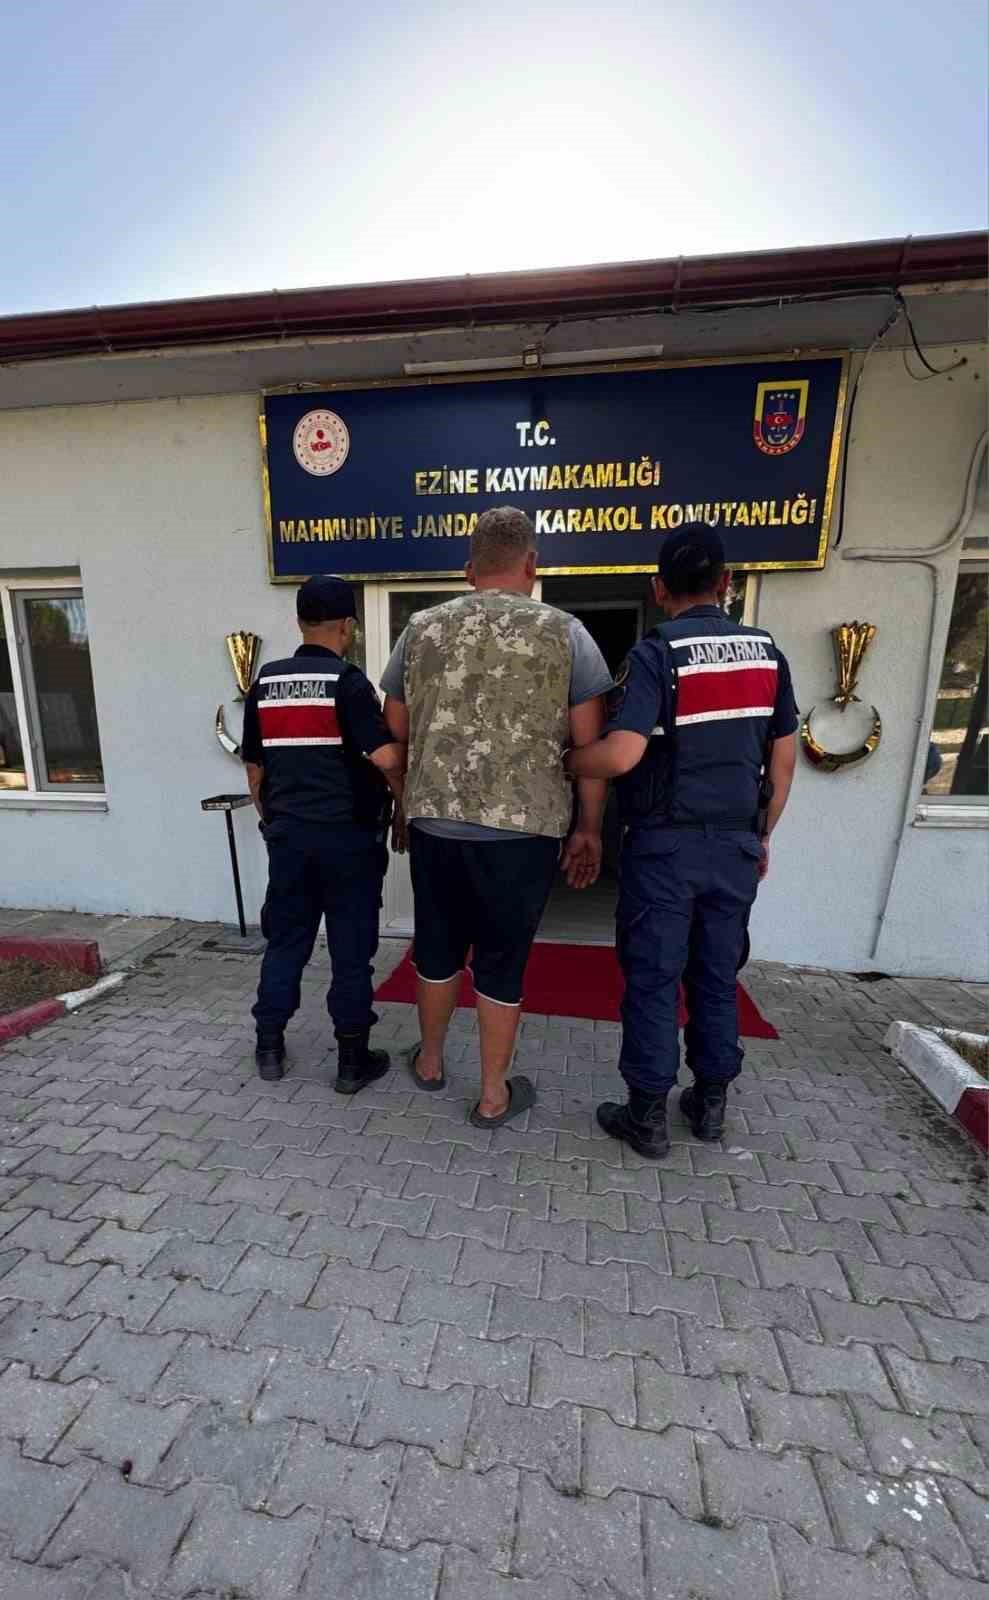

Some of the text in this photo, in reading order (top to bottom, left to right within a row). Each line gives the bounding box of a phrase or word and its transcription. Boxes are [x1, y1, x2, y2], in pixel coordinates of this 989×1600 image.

[516, 420, 556, 447] T.C.
[415, 456, 661, 495] EZİNE KAYMAKAMLIĞI
[279, 512, 403, 543] MAHMUDİYE
[535, 506, 643, 535] KARAKOL
[651, 493, 817, 530] KOMUTANLIĞI
[688, 641, 768, 665] JANDARMA
[265, 680, 327, 700] JANDARMA
